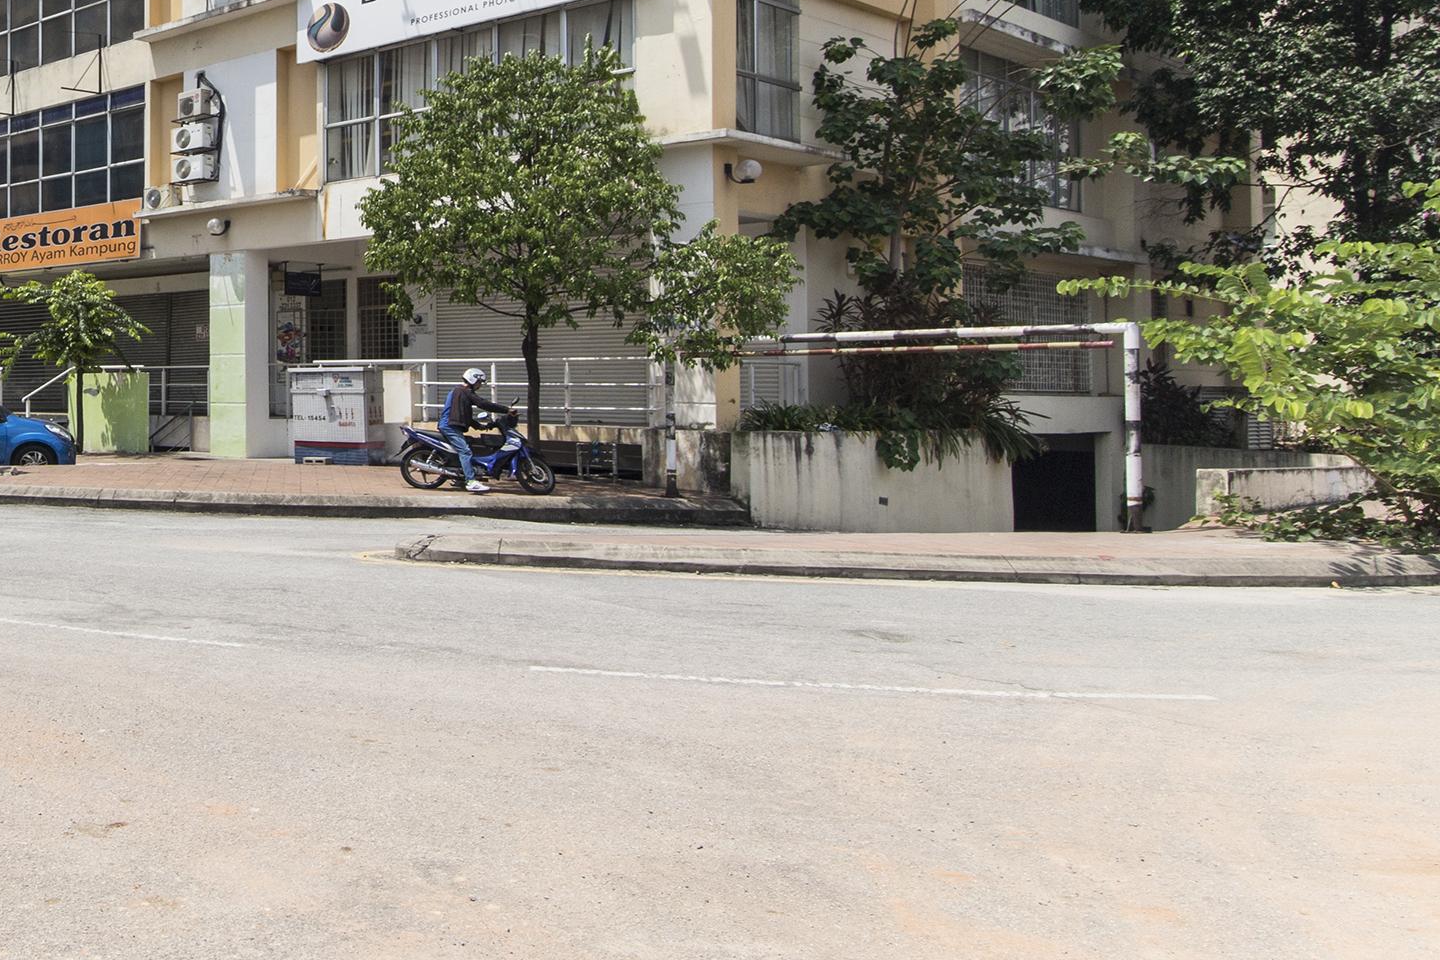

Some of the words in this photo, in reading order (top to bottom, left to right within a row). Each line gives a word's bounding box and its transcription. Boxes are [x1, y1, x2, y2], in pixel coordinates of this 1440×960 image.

[410, 2, 479, 26] PROFESSIONAL
[30, 248, 66, 264] Ayam
[69, 240, 137, 258] Kampung
